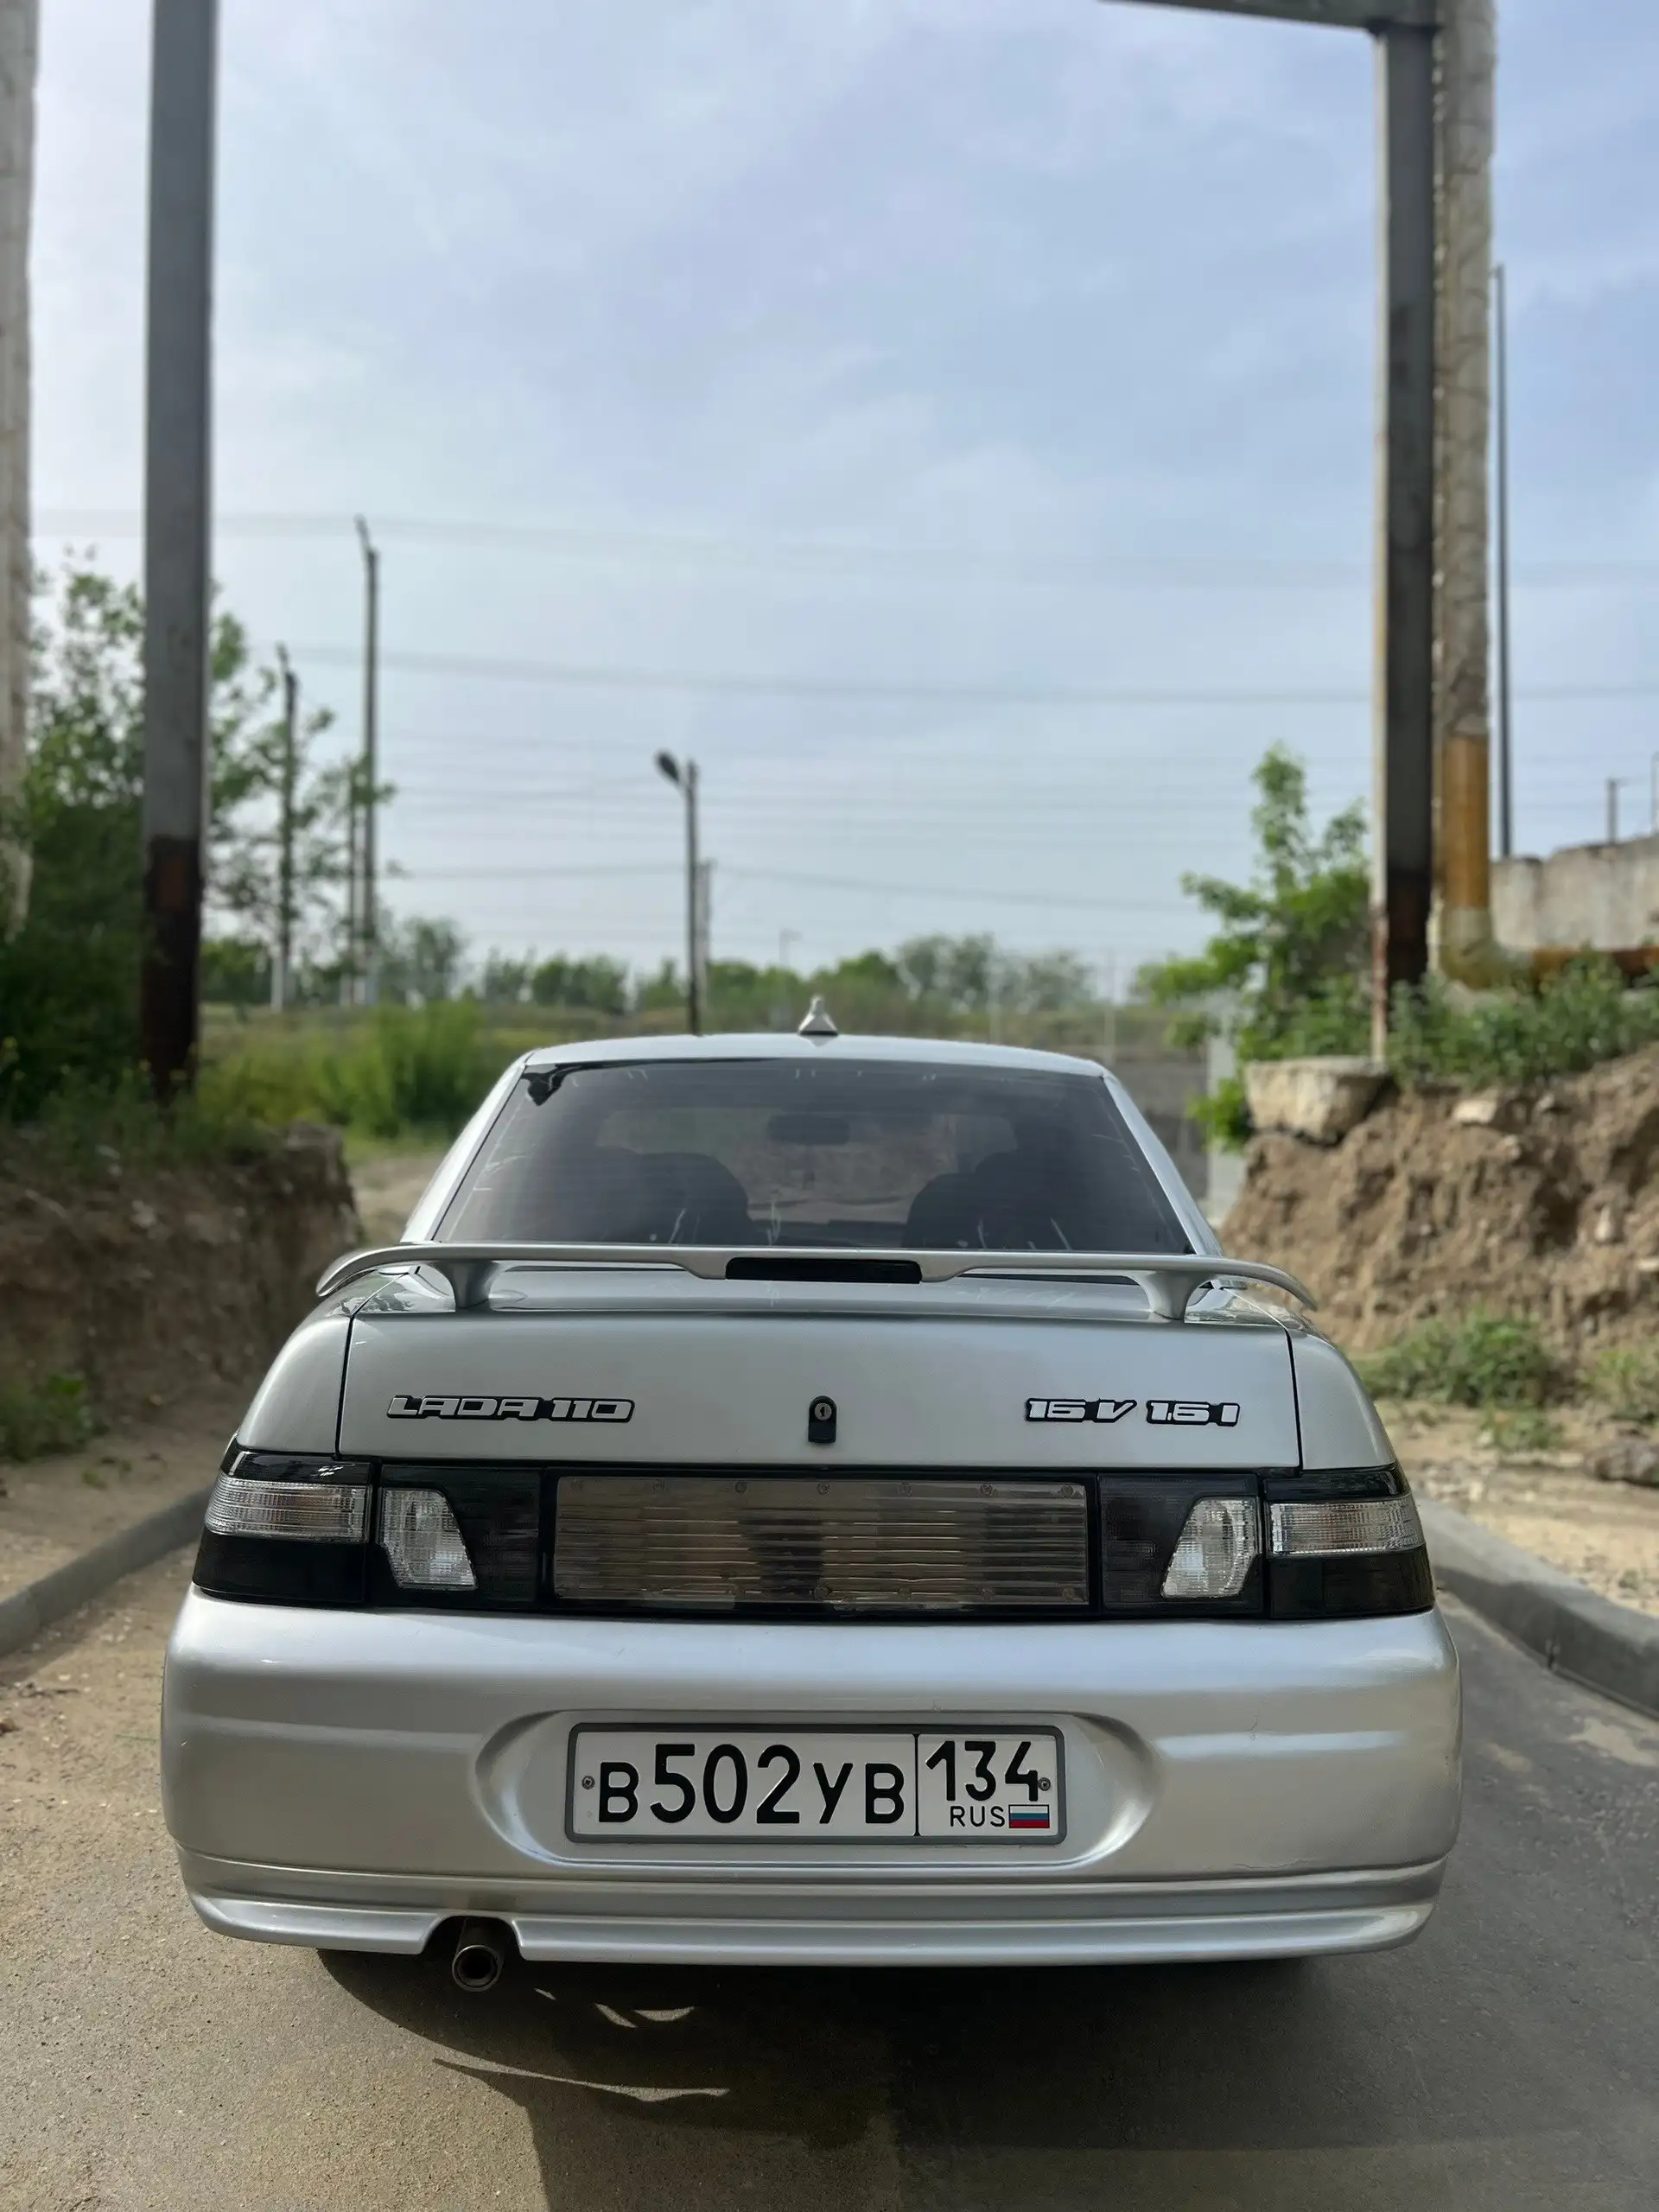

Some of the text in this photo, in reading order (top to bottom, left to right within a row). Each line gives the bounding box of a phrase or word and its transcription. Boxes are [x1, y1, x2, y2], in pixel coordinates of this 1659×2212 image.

[388, 1396, 633, 1422] LADA 110
[599, 1744, 904, 1824] В502УВ
[925, 1741, 1039, 1802] 134
[950, 1806, 1006, 1827] RUS
